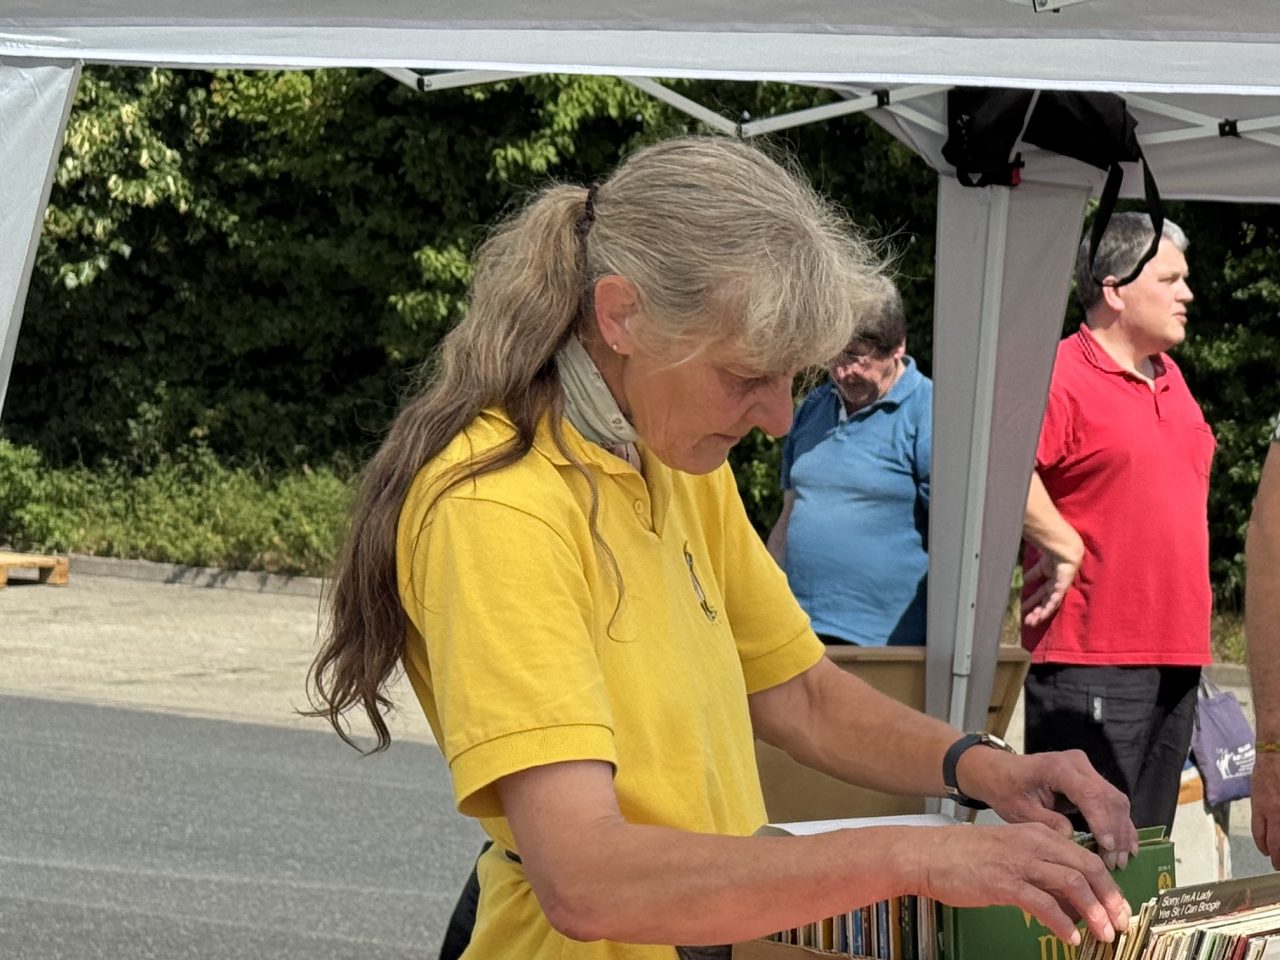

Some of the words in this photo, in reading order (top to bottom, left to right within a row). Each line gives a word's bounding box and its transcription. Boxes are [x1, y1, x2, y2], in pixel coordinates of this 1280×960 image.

[1197, 890, 1214, 902] Lady
[1158, 909, 1170, 920] Yes
[1185, 904, 1198, 915] Can
[1197, 901, 1220, 913] Boogie
